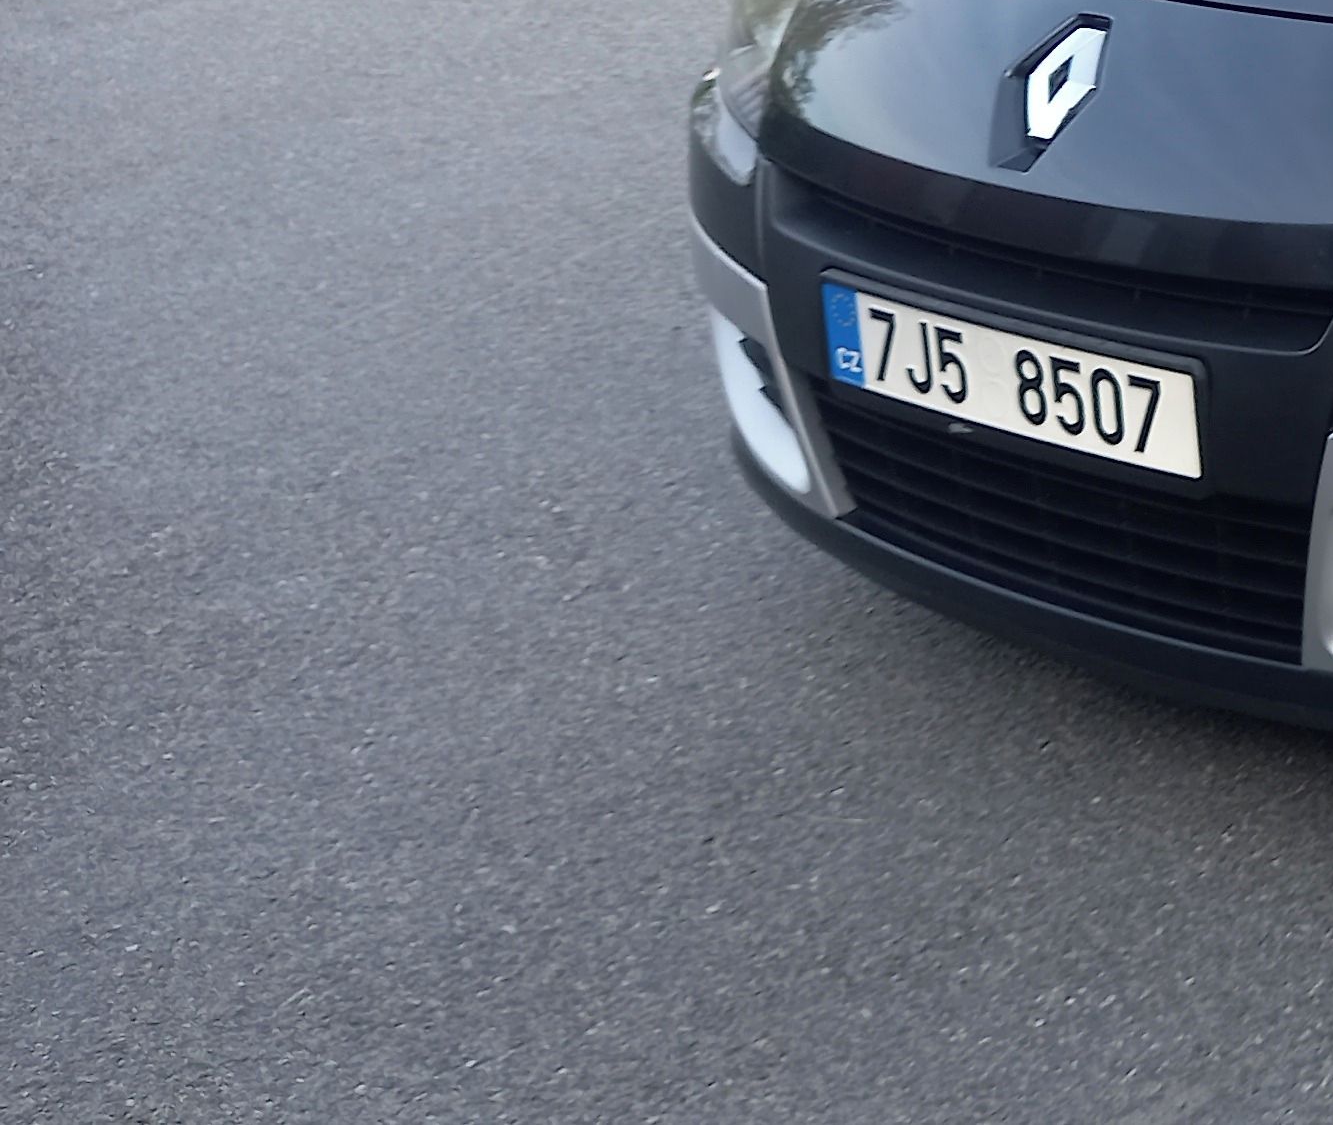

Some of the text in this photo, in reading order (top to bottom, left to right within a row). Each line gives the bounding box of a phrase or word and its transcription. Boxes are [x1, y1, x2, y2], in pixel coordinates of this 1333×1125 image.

[835, 347, 863, 373] CZ
[868, 308, 1161, 453] 7J5 8507
